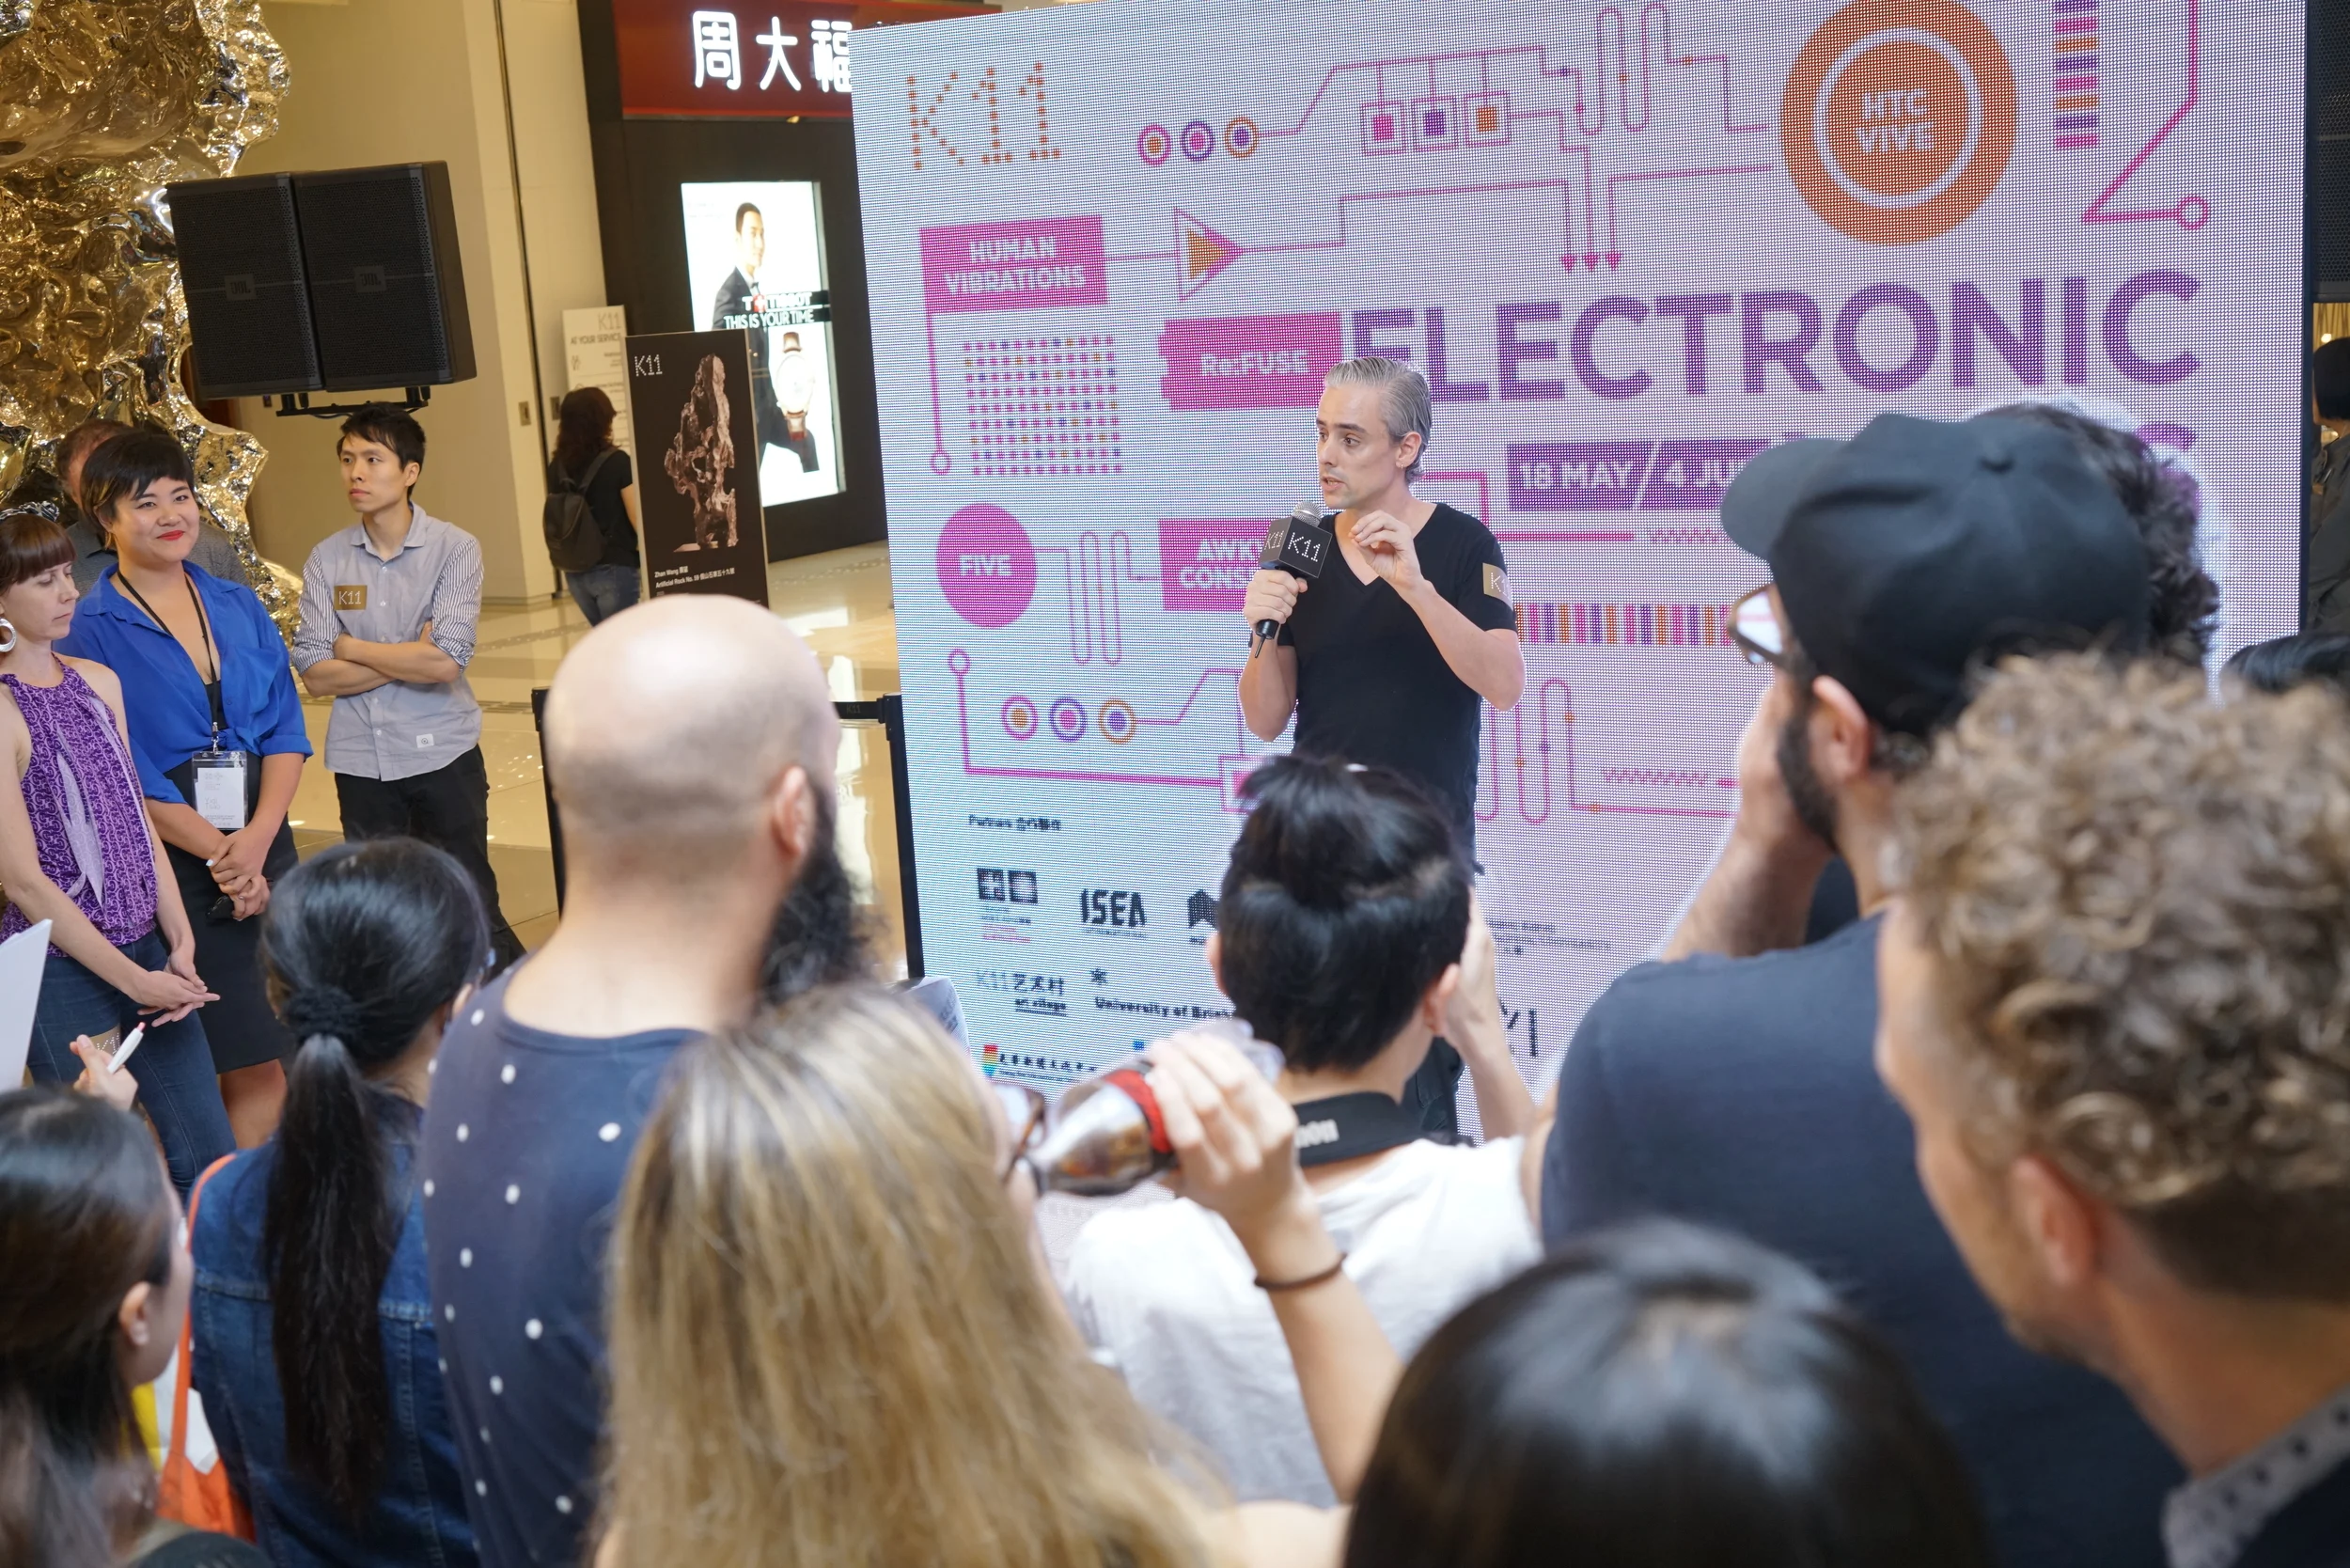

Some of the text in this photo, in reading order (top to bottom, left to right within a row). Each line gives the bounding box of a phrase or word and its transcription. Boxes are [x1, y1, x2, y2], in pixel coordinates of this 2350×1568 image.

[692, 10, 853, 93] 周大福
[906, 61, 1061, 170] K11
[1862, 88, 1929, 120] HTC
[1855, 120, 1935, 153] VIVE
[969, 235, 1057, 262] HUMAN
[944, 264, 1087, 295] VIBRATIONS
[598, 312, 621, 331] K11
[724, 307, 815, 329] THIS IS YOUR TIME
[579, 335, 596, 345] YOUR
[597, 332, 621, 343] SERVICE
[1353, 269, 2201, 402] ELECTRONIC
[634, 353, 663, 377] K11
[1200, 349, 1309, 377] Re:FUSE
[1519, 459, 1747, 489] 18 MAY 4 JU
[1264, 530, 1284, 550] K11
[1288, 531, 1321, 563] K11
[959, 553, 1012, 578] FIVE
[1179, 566, 1260, 589] CONS
[338, 590, 361, 604] K11
[1081, 888, 1146, 928] ISEA
[1094, 996, 1168, 1018] University
[1173, 1005, 1188, 1017] of
